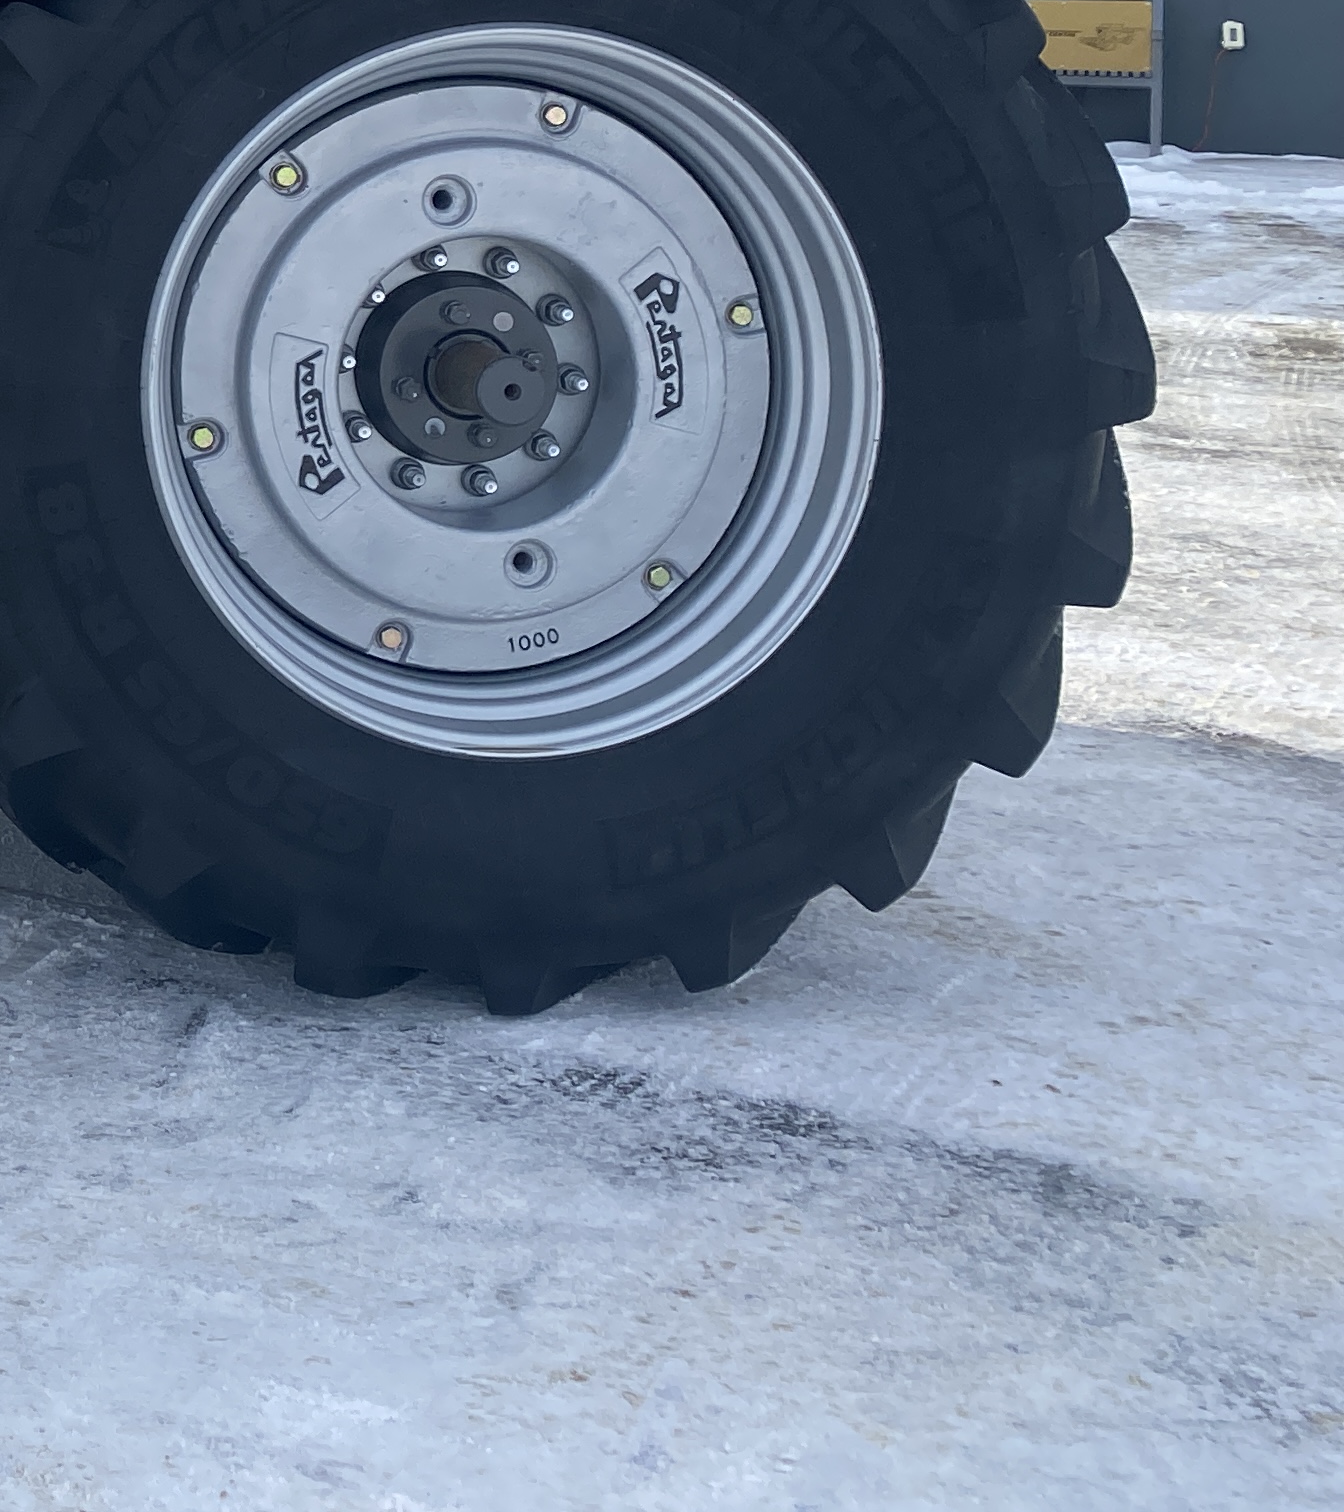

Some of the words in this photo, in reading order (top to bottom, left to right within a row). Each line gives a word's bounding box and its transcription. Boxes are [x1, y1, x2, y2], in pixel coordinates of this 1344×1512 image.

[634, 272, 683, 419] Pentagon
[295, 349, 345, 495] Pentagon
[508, 628, 559, 652] 1000
